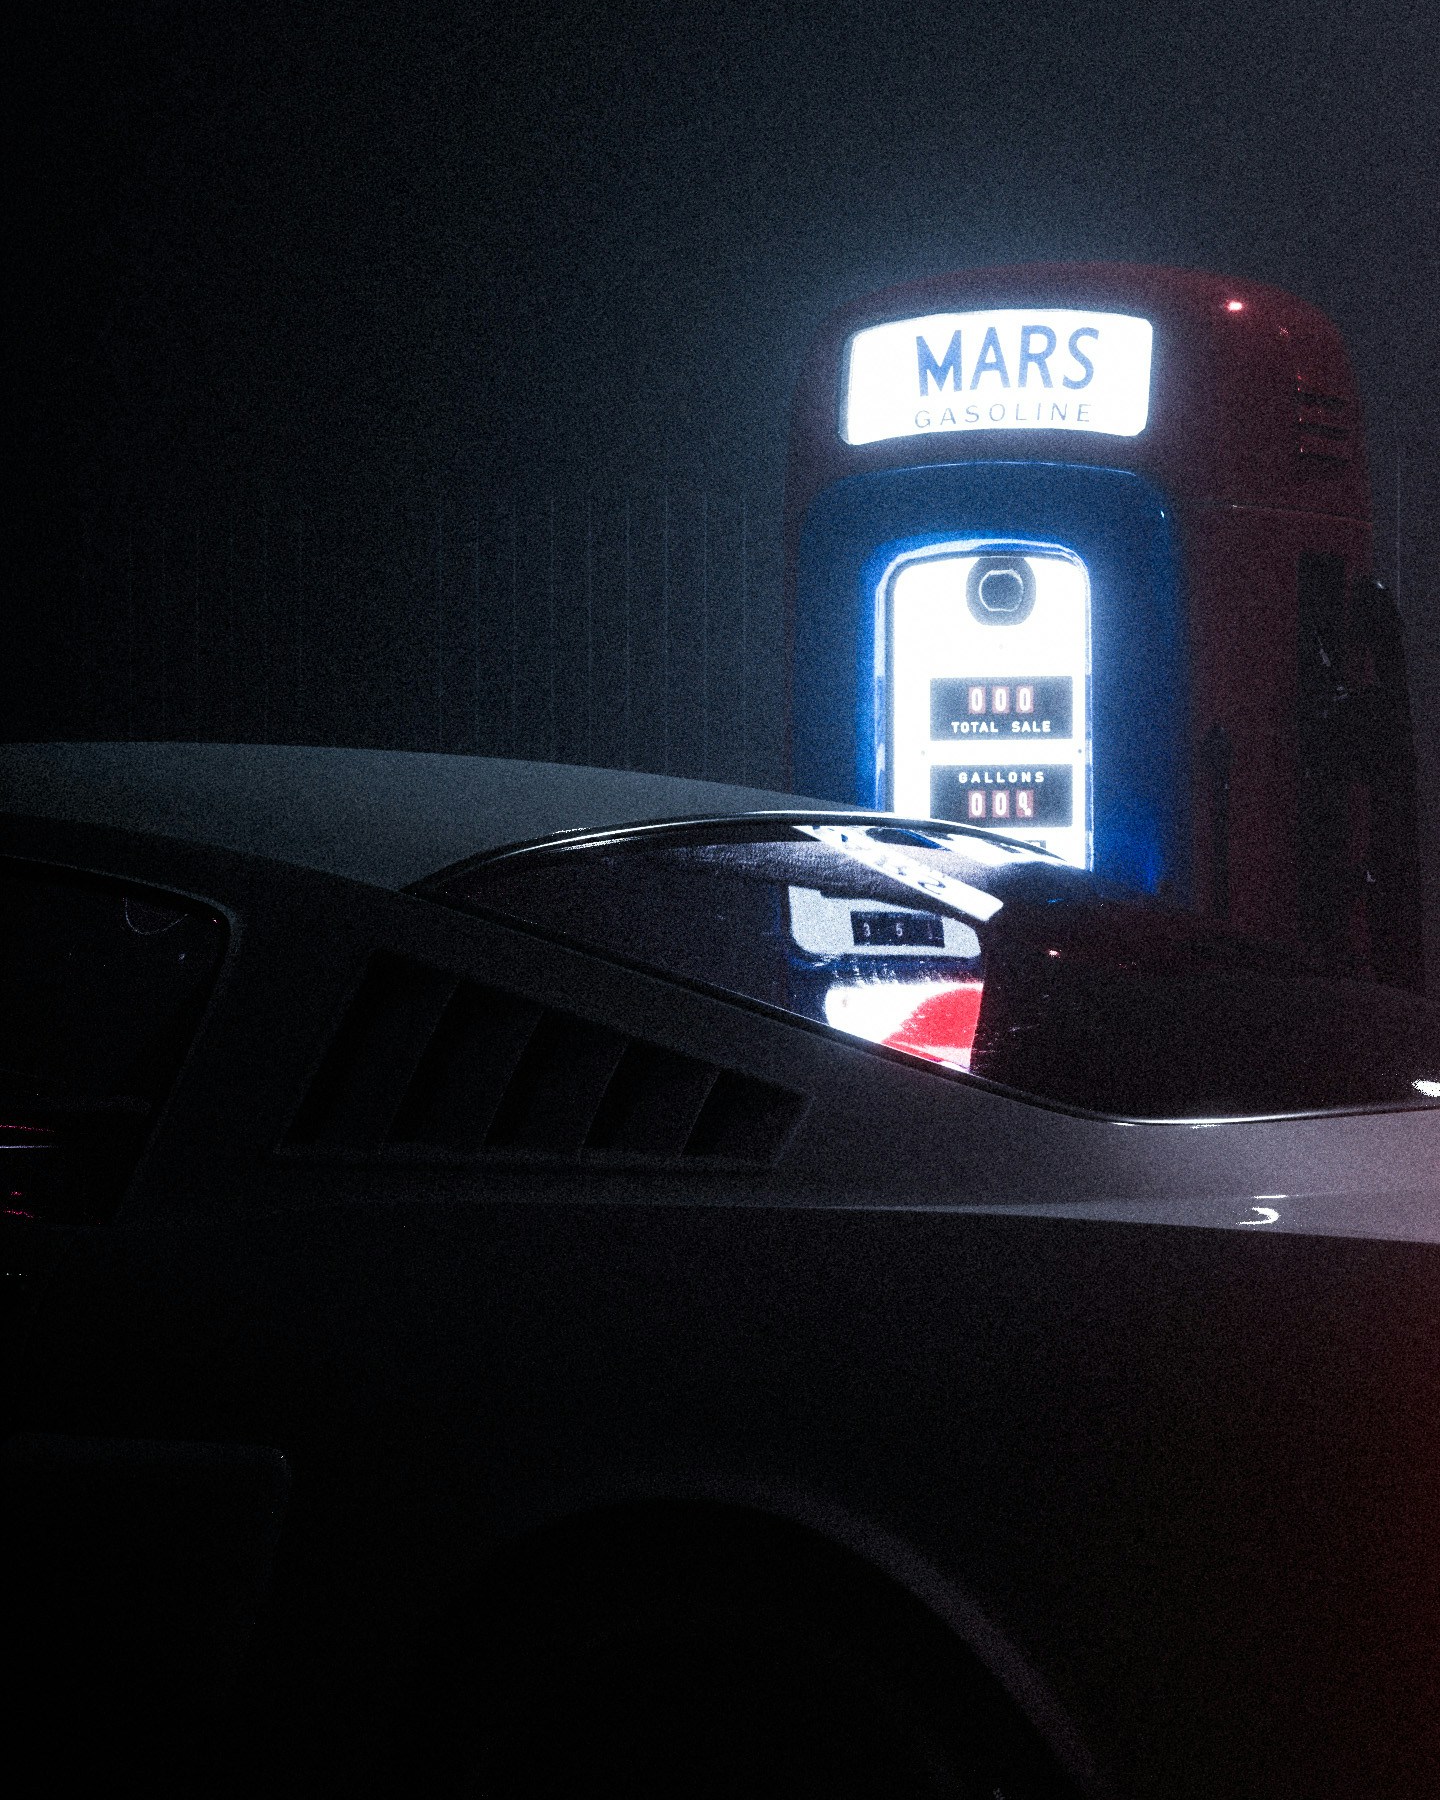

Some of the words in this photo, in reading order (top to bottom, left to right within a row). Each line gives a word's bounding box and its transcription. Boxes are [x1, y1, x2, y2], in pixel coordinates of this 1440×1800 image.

[916, 325, 1100, 396] MARS
[914, 403, 1091, 430] GASOLINE
[951, 721, 998, 733] TOTAL
[1012, 720, 1051, 732] SALE
[958, 772, 1045, 783] GALLONS
